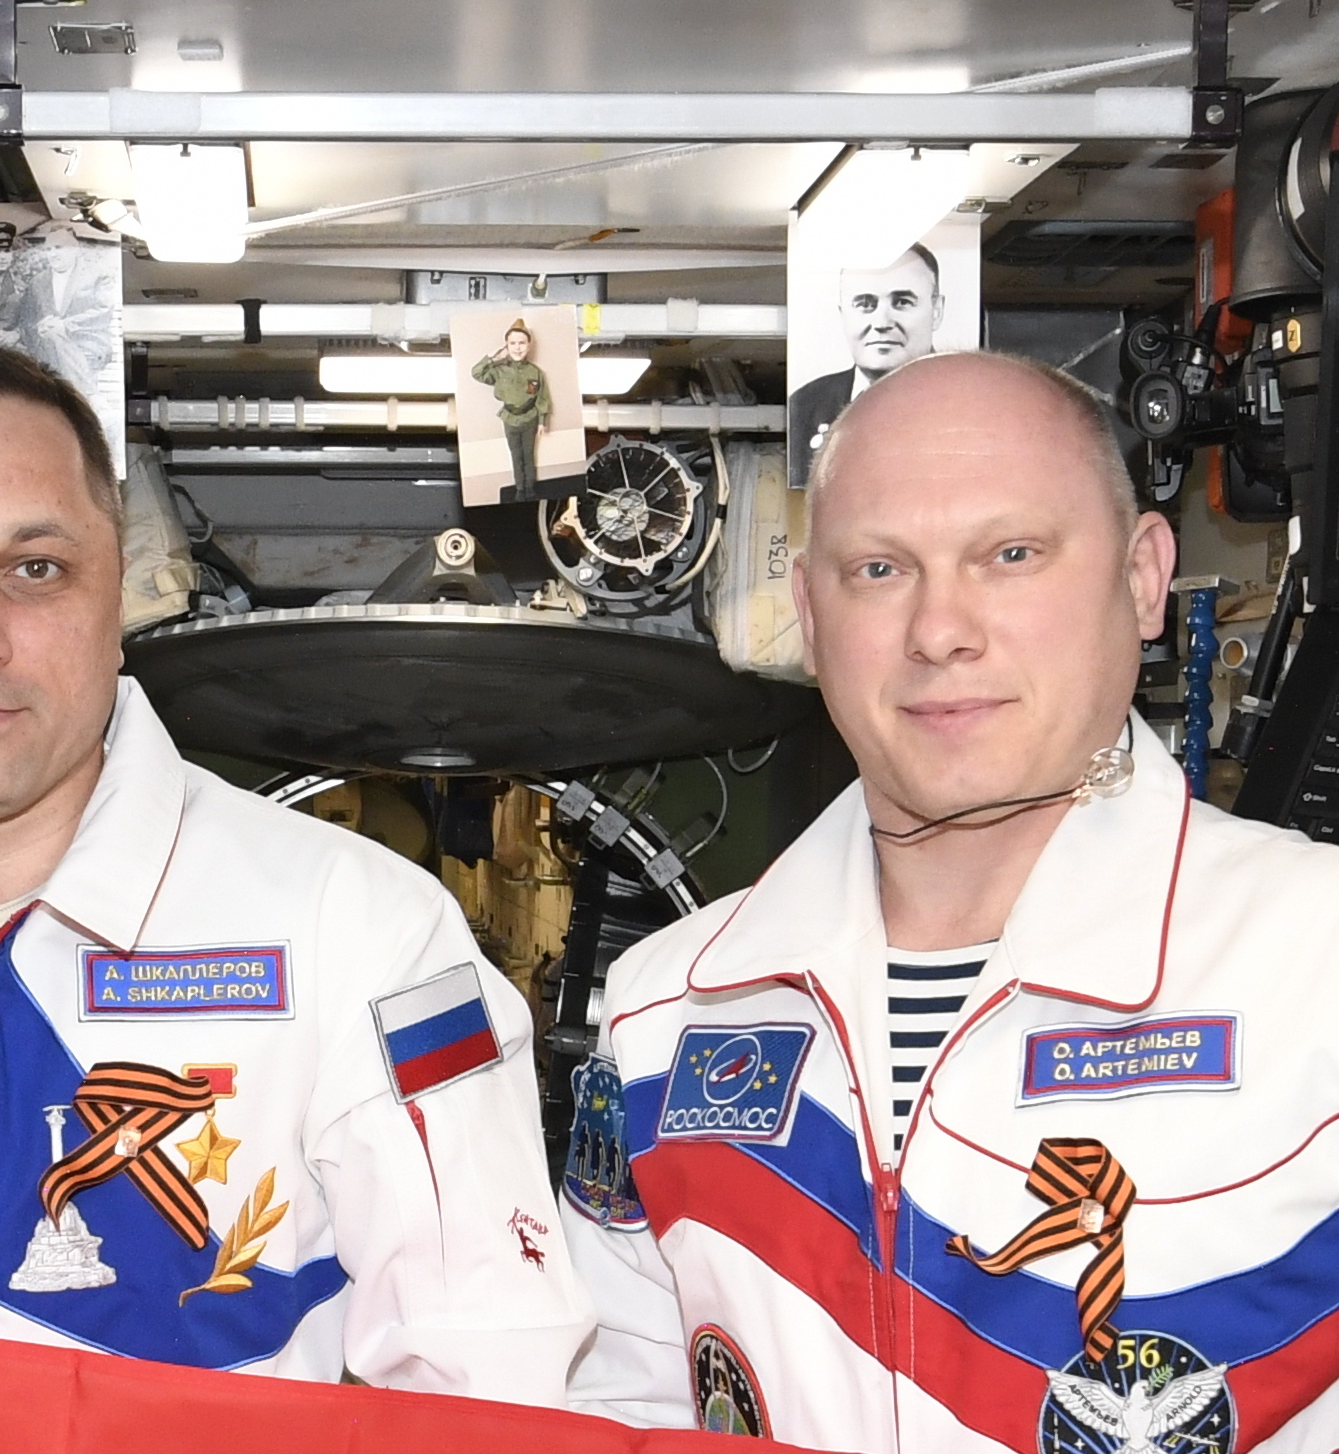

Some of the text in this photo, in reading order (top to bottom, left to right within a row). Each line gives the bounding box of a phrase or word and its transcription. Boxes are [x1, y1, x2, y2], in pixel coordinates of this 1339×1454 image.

[767, 533, 788, 580] 1038
[105, 962, 266, 982] А. ШКАПЛЕРОВ
[102, 982, 270, 1003] A. SHKAPLEROV
[1053, 1030, 1202, 1060] О. АРТЕМЬЕВ
[1053, 1051, 1198, 1081] O. ARTEMIEV
[664, 1106, 778, 1131] РОСКОСМОС
[1116, 1338, 1161, 1369] 56
[1166, 1385, 1203, 1422] ARNOLD
